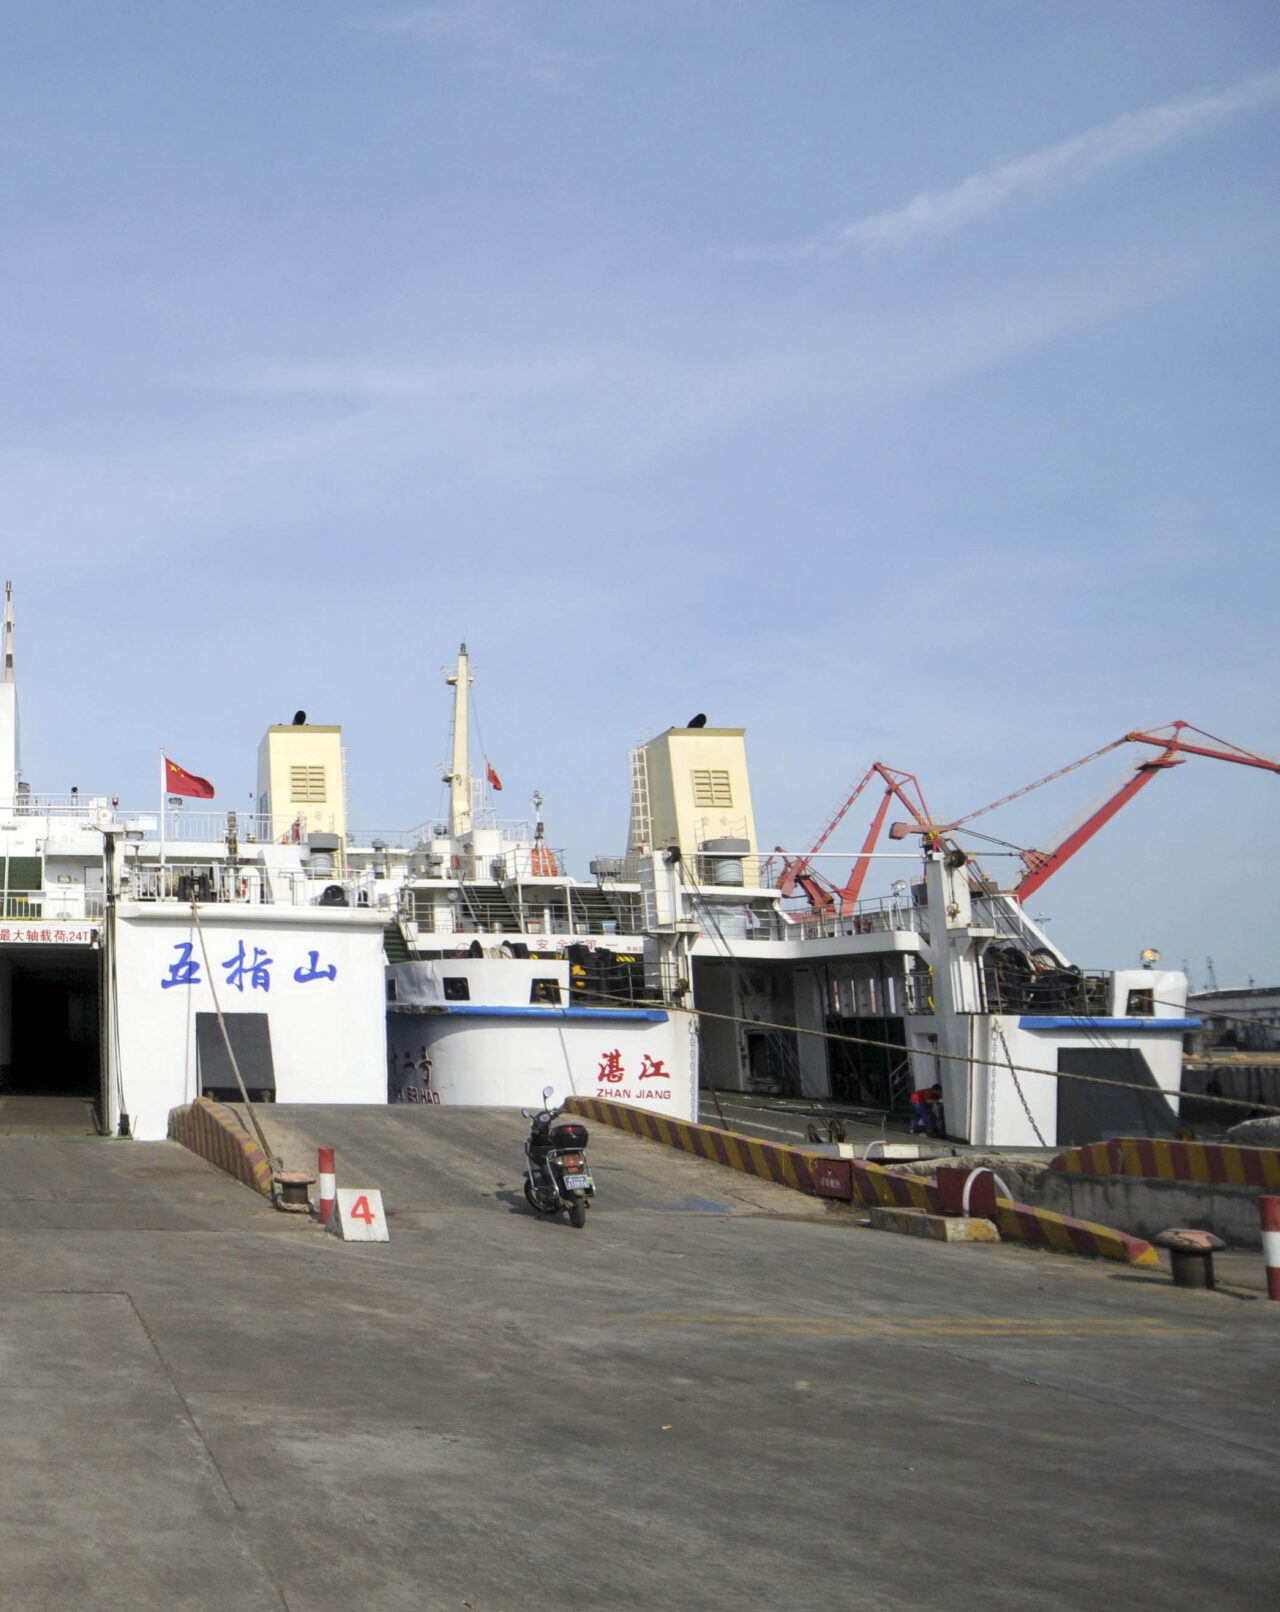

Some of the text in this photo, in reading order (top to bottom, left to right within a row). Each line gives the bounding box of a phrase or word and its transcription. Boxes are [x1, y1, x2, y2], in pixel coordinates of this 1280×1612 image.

[161, 939, 337, 992] 五指山
[597, 1048, 670, 1083] 湛江
[596, 1088, 672, 1100] ZHAN JIANG
[350, 1195, 375, 1225] 4
